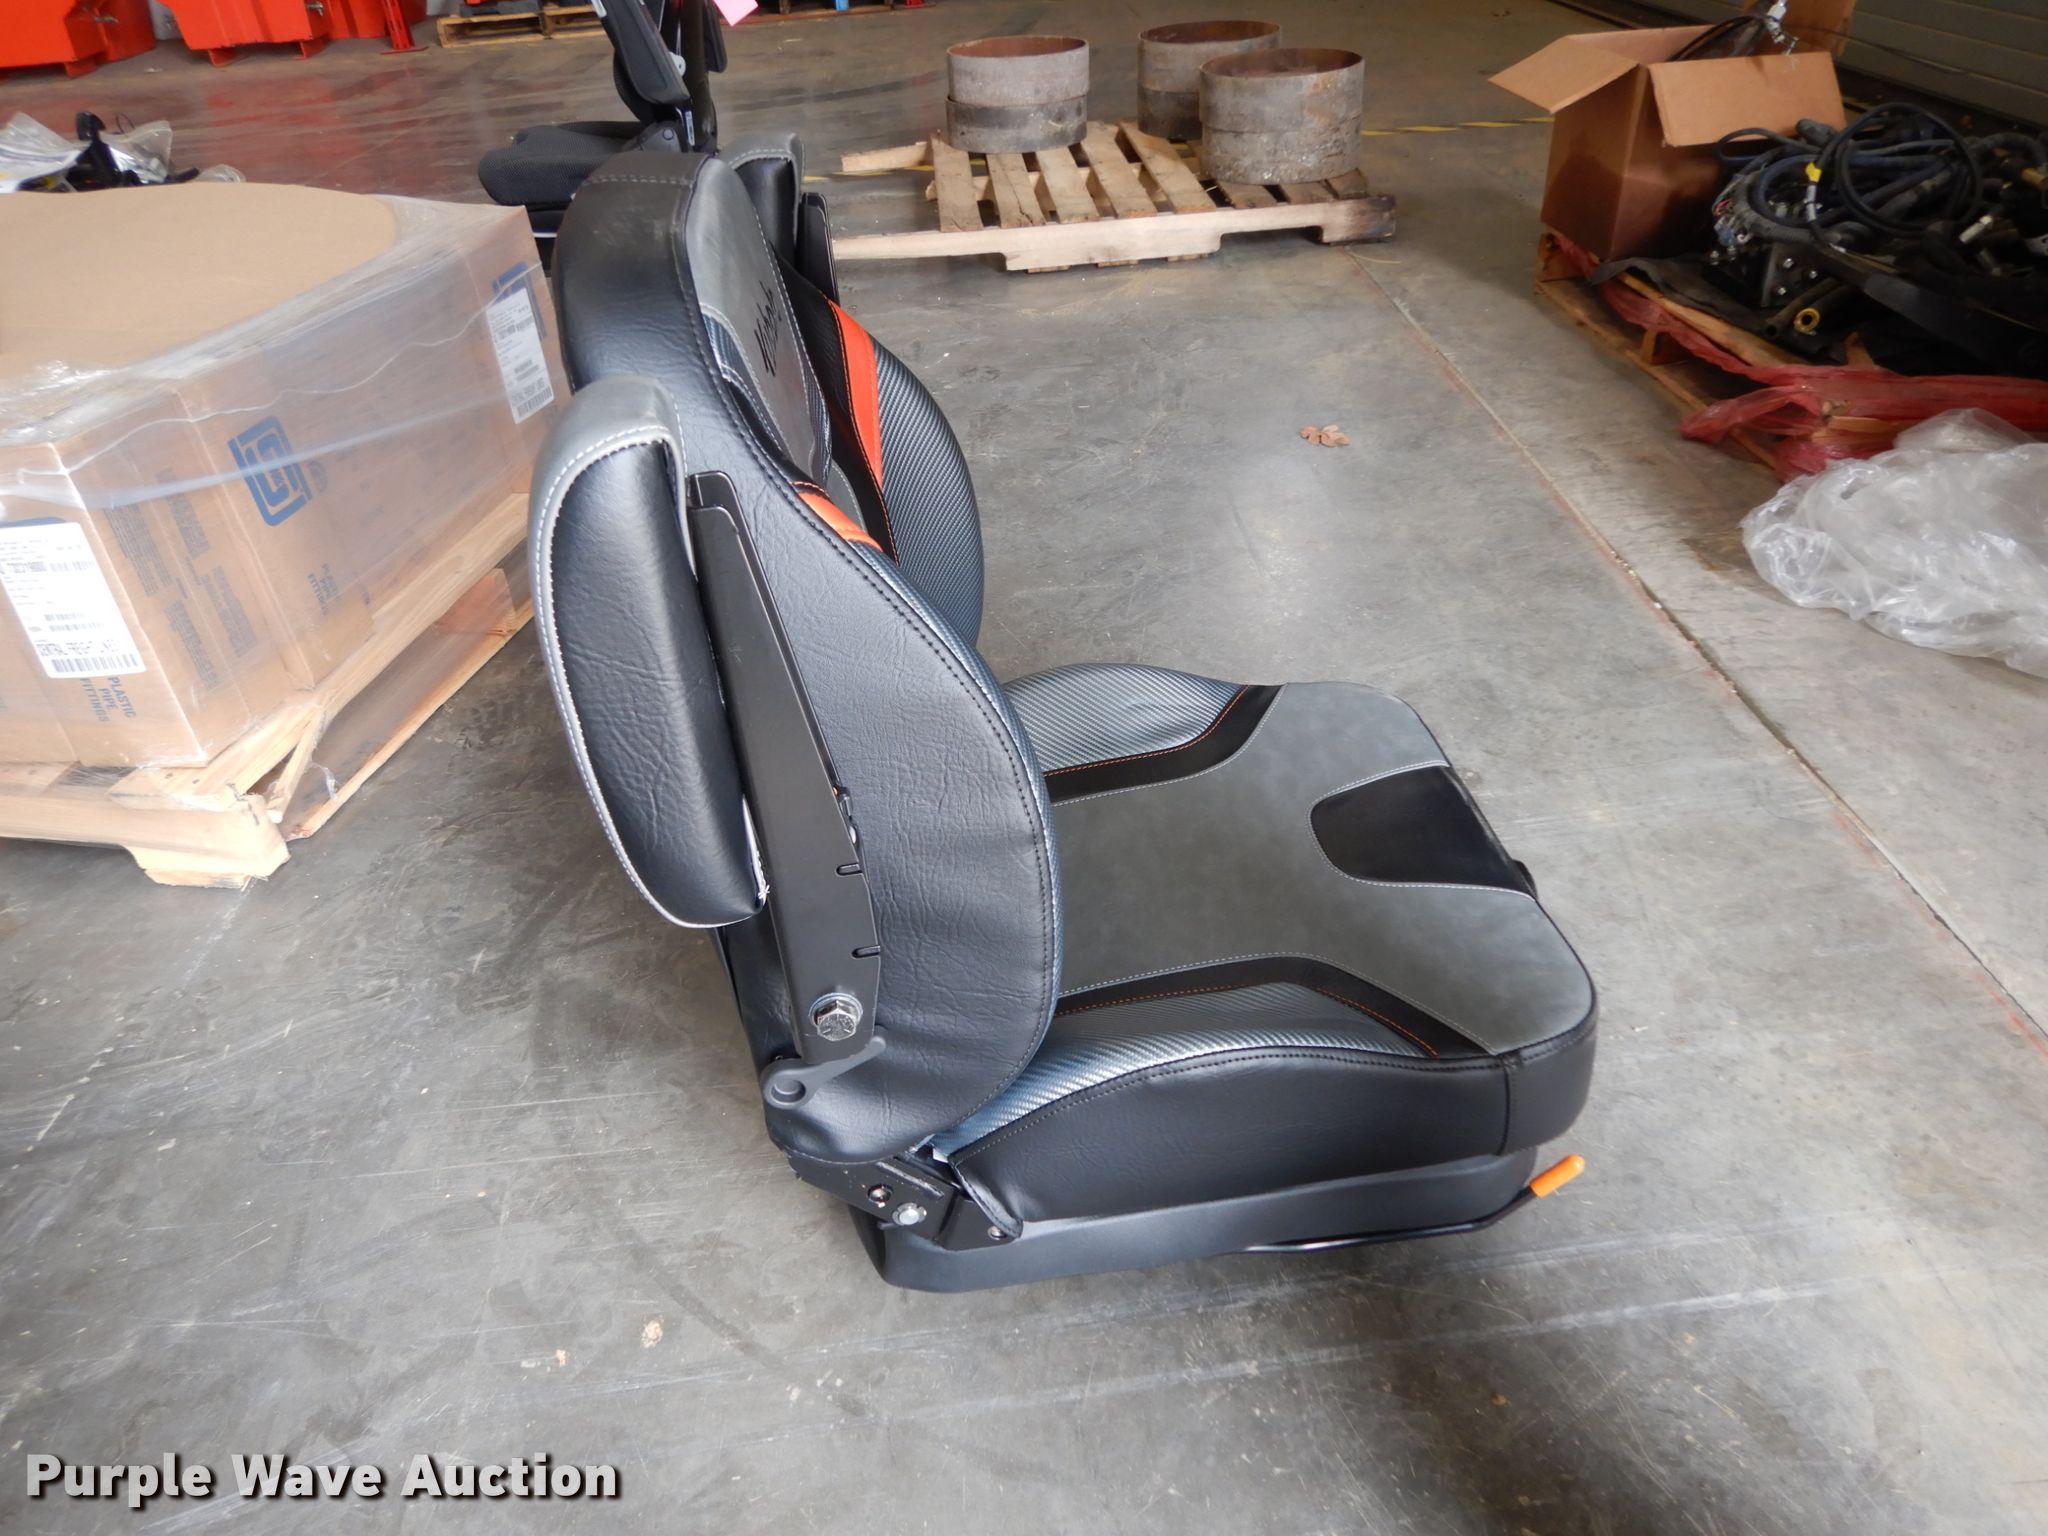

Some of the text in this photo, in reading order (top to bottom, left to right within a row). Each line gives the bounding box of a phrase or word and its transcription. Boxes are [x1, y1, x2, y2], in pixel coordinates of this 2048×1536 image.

[80, 677, 110, 721] FITTINGS
[99, 688, 119, 710] PIPE
[107, 676, 136, 718] PLASTIC
